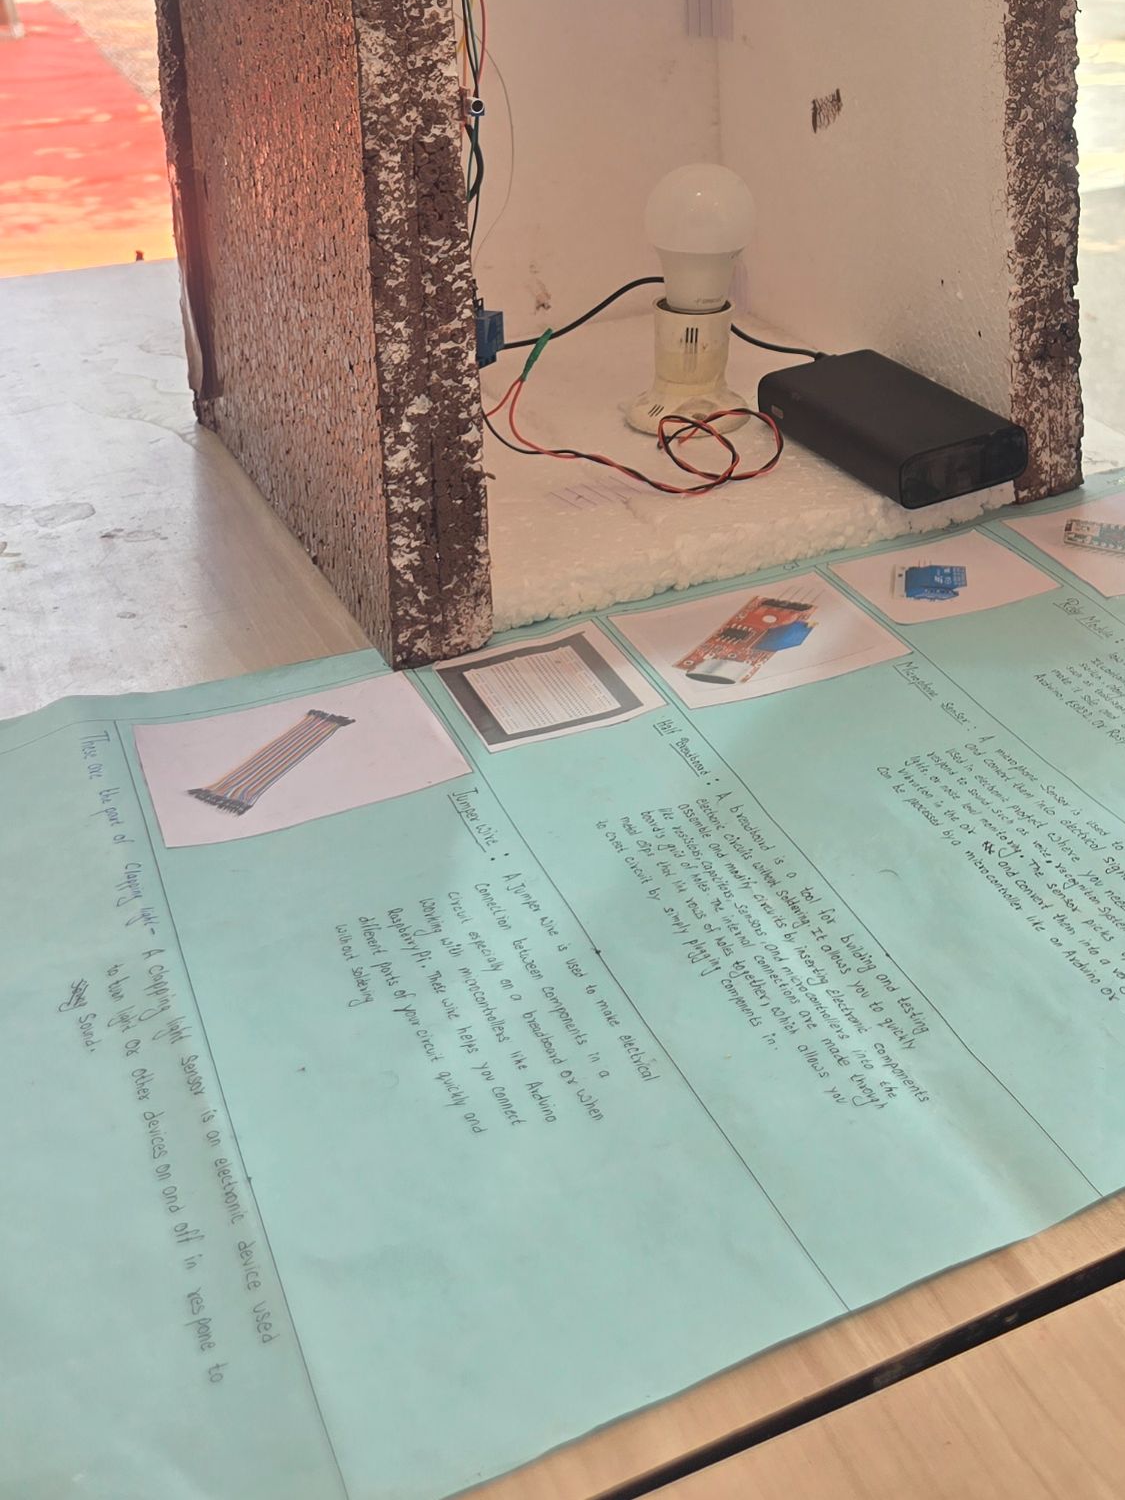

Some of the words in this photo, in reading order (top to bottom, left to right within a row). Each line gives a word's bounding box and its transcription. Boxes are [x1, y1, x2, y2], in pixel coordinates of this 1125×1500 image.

[89, 806, 124, 826] part
[112, 833, 135, 844] of
[141, 948, 165, 960] A
[773, 856, 784, 865] is
[799, 886, 822, 903] tool
[875, 973, 898, 992] and
[896, 996, 929, 1035] testing
[369, 961, 400, 986] parts
[393, 989, 416, 999] of
[468, 931, 503, 972] especially
[499, 978, 514, 990] on
[509, 993, 522, 1001] a
[522, 1009, 566, 1064] breadboard
[512, 937, 543, 979] between
[587, 1051, 600, 1063] in
[597, 1069, 610, 1078] a
[106, 1004, 140, 1033] light
[393, 1003, 420, 1025] your
[556, 943, 568, 952] is
[565, 957, 586, 977] used
[585, 984, 597, 994] to
[595, 999, 620, 1027] make
[618, 1034, 660, 1081] electrical
[151, 1015, 192, 1044] light
[457, 1025, 479, 1054] helps
[471, 1061, 495, 1081] you
[796, 1044, 829, 1078] allows
[821, 1037, 850, 1066] made
[434, 1071, 469, 1107] quickly
[510, 1050, 527, 1070] like
[525, 1081, 556, 1122] Arduino
[879, 1080, 897, 1098] the
[200, 1108, 217, 1123] is
[463, 1112, 488, 1133] and
[142, 1111, 167, 1159] devices
[205, 1129, 221, 1147] an
[154, 1163, 171, 1180] on
[161, 1185, 183, 1213] and
[213, 1157, 244, 1224] electronic
[173, 1222, 205, 1243] off
[183, 1253, 203, 1270] in
[237, 1240, 261, 1290] device
[252, 1300, 277, 1344] used
[207, 1362, 228, 1383] to
